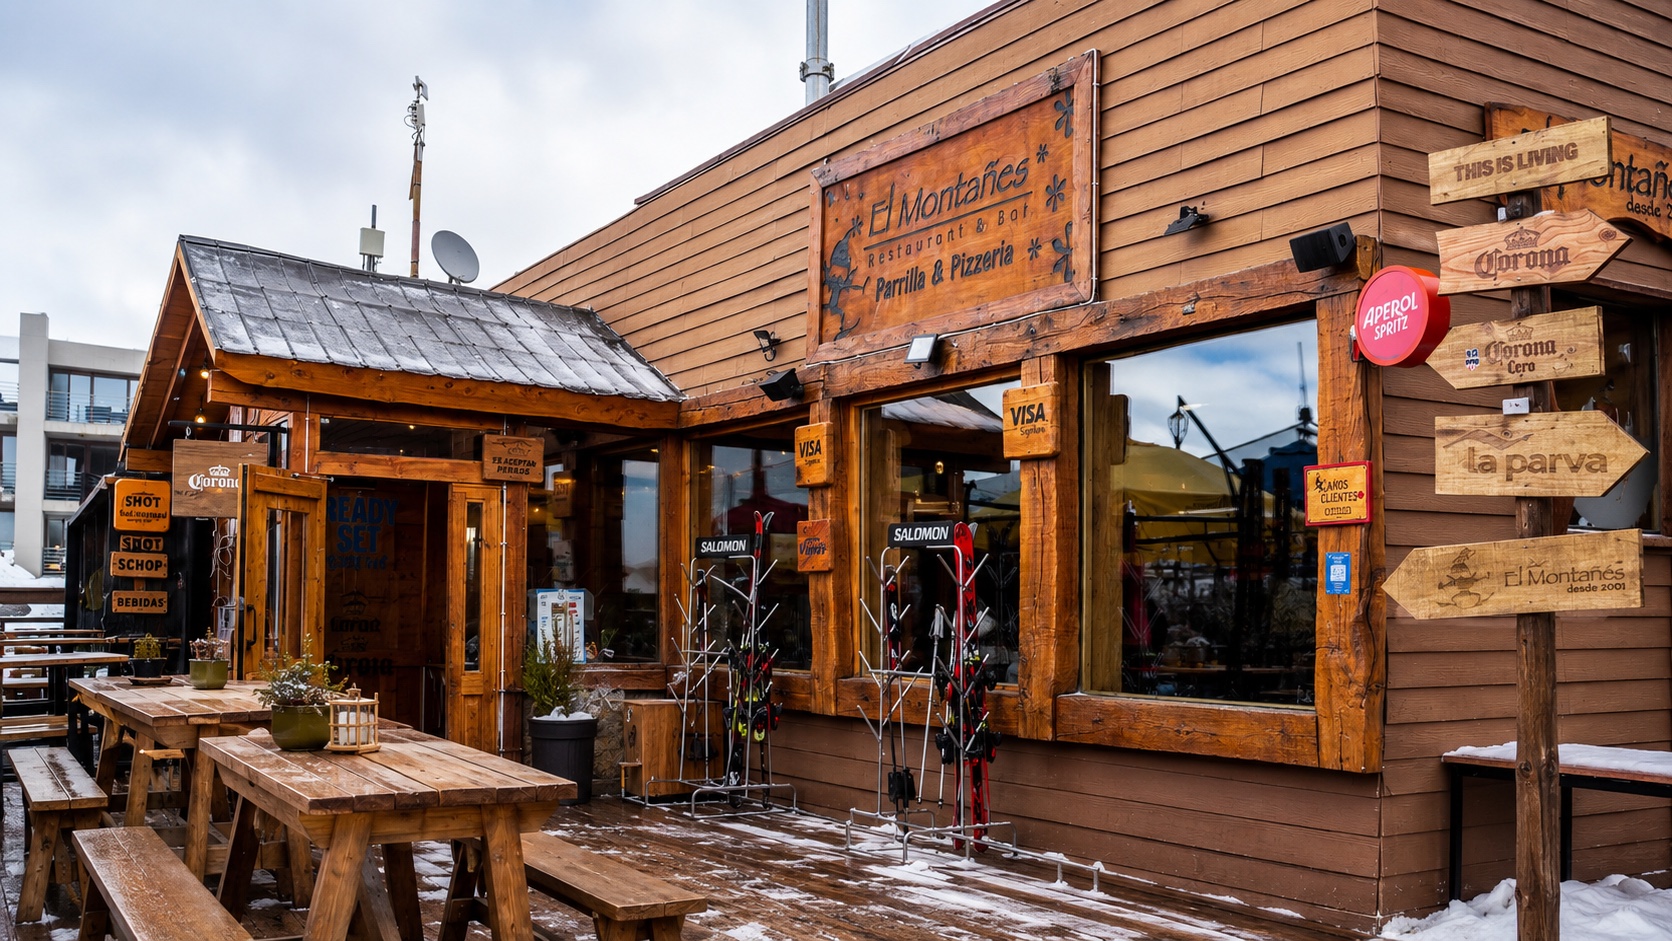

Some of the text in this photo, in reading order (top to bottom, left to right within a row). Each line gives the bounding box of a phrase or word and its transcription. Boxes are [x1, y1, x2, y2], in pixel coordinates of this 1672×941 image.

[1454, 142, 1579, 182] THIS IS LIVING
[868, 158, 1029, 238] El Montañes
[1626, 194, 1661, 217] desde
[868, 202, 1029, 268] Restaurant & Bar
[875, 240, 1014, 302] Parrilla & Pizzeria
[1474, 246, 1571, 284] Corona
[1362, 292, 1418, 329] APEROL
[1374, 315, 1408, 341] SPRITZ
[1485, 339, 1557, 366] Corona
[1507, 360, 1536, 375] Cero
[1010, 402, 1046, 426] VISA
[799, 439, 822, 458] VISA
[1467, 446, 1608, 482] la parva
[125, 495, 161, 508] SHOT
[1321, 491, 1358, 504] CLIENTES
[337, 523, 382, 553] SET
[893, 526, 950, 542] SALOMON
[700, 540, 747, 553] SALOMON
[118, 558, 163, 571] SCHOP
[1505, 566, 1523, 587] El
[1567, 582, 1626, 593] desde 2001
[117, 597, 164, 607] BEBIDAS
